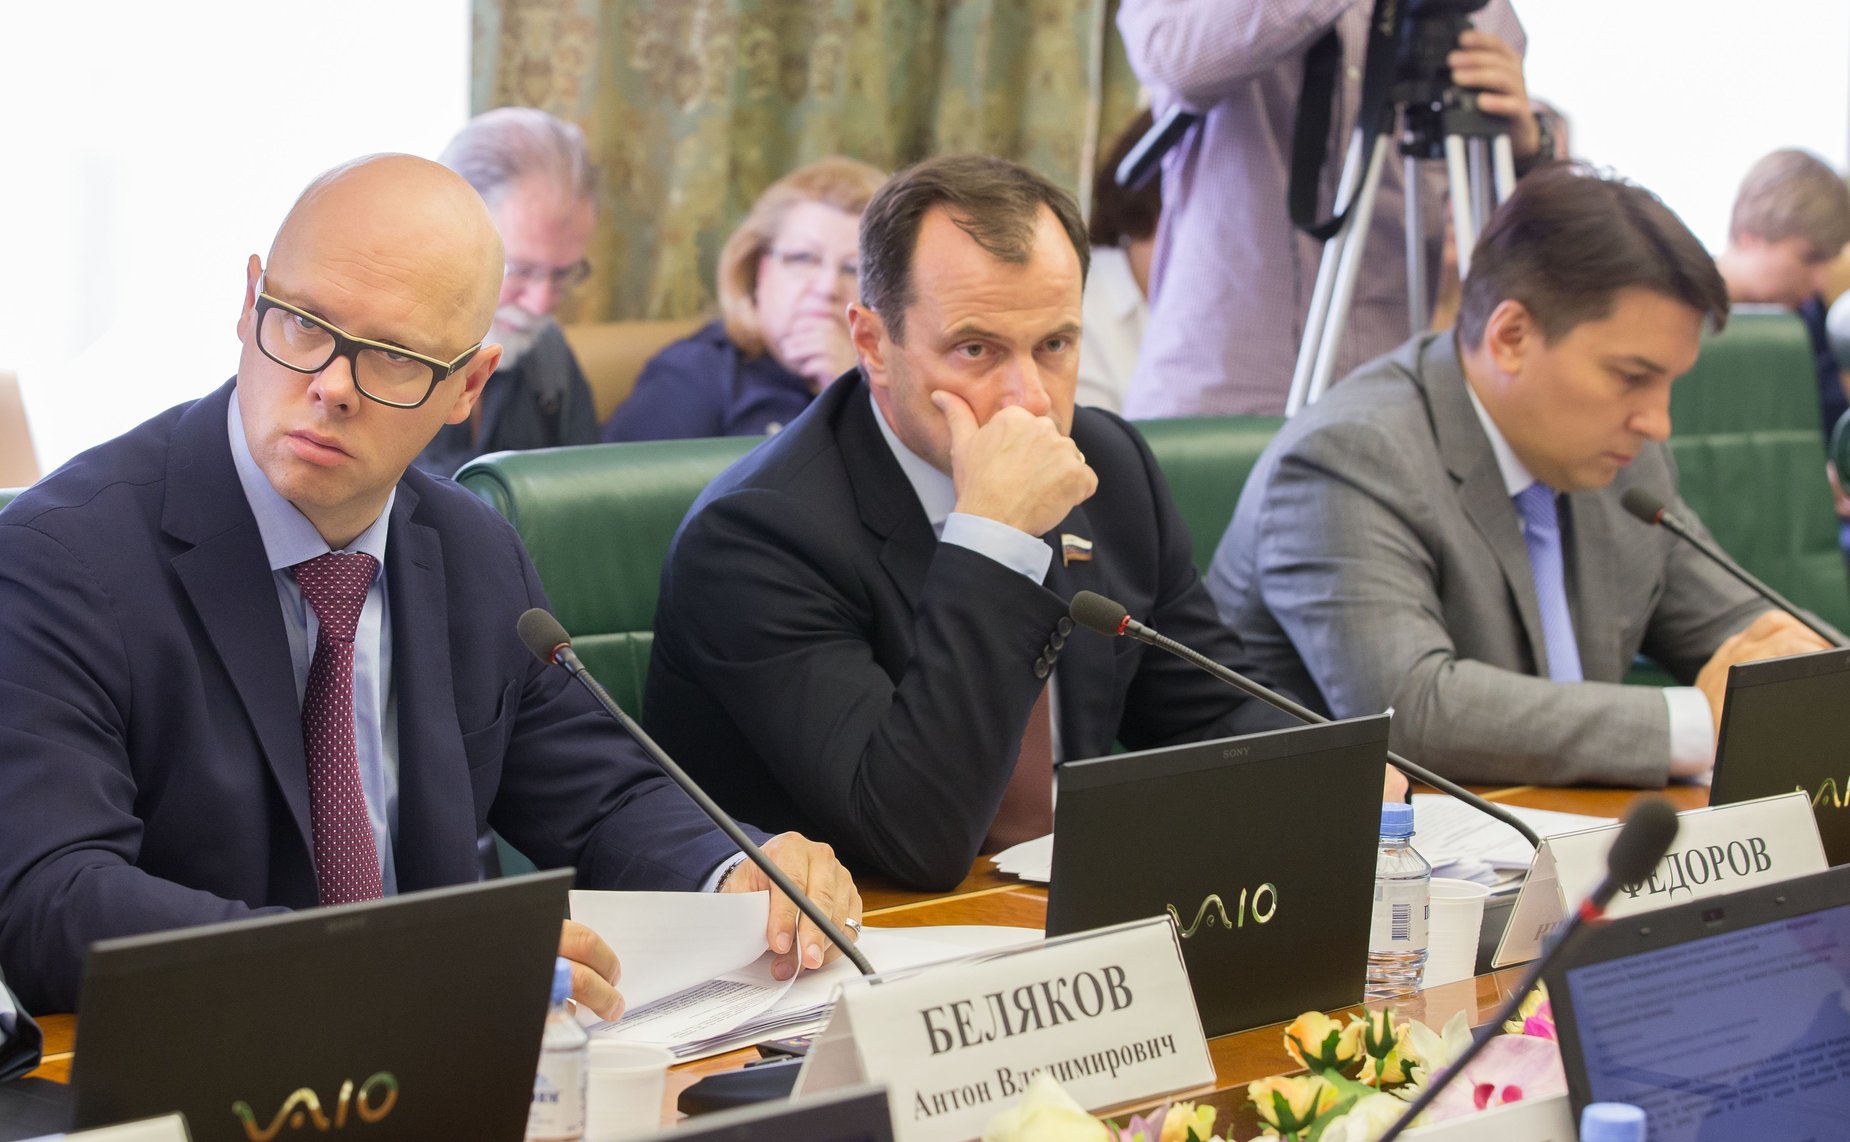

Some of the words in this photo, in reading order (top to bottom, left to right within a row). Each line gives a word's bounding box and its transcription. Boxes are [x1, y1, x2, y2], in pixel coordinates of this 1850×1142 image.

[1223, 746, 1250, 759] SONY
[1166, 882, 1278, 938] VAIO
[918, 965, 1134, 1056] БЕЛЯКОВ
[231, 1070, 399, 1142] VAIO
[913, 1079, 994, 1120] Антон
[995, 1034, 1177, 1098] Влдимирович
